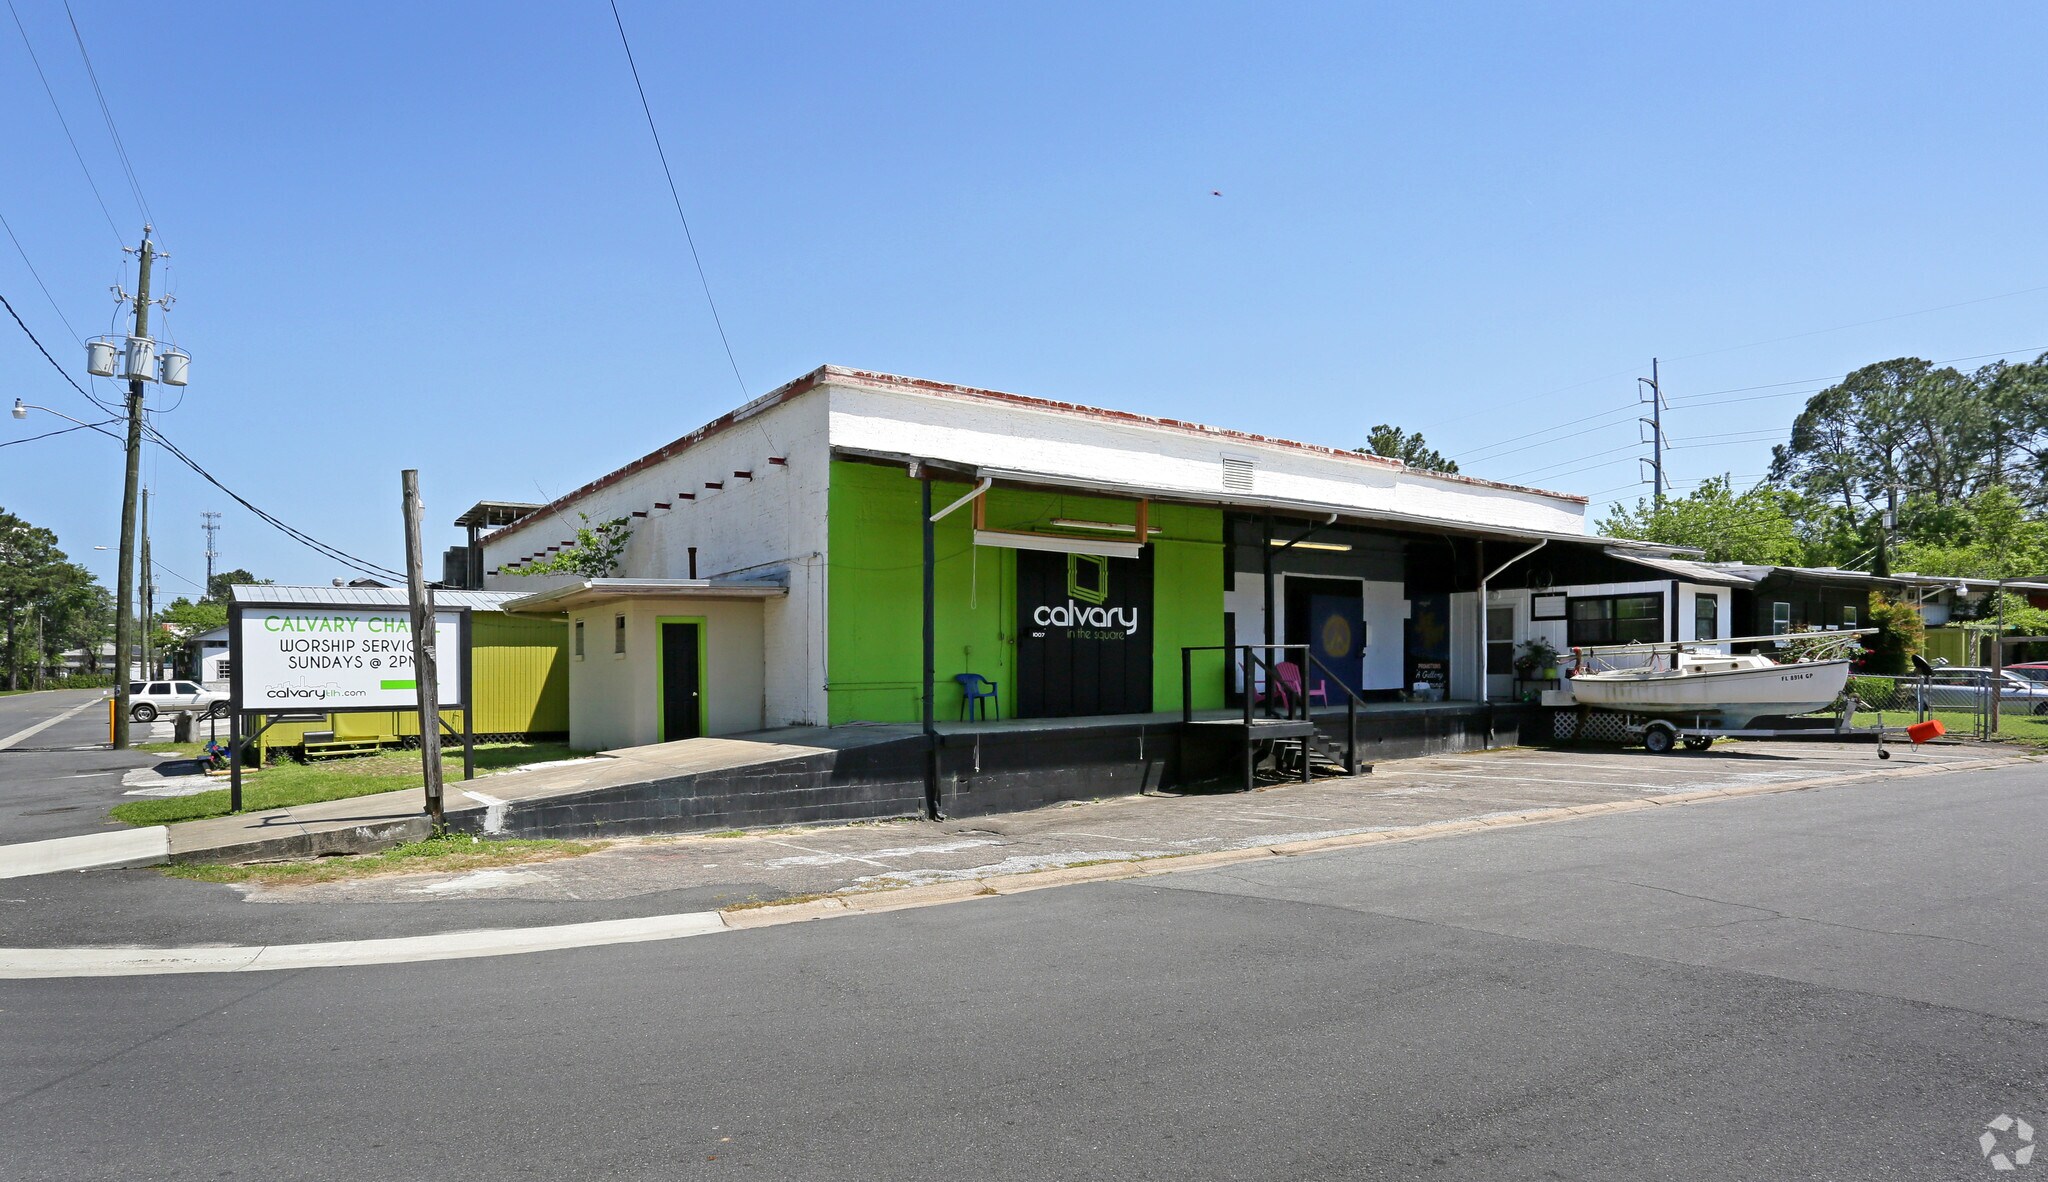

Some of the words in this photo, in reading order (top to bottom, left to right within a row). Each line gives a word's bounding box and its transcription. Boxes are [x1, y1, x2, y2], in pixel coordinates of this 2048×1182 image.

[1033, 599, 1138, 635] calvary
[264, 615, 359, 633] CALVARY
[1067, 629, 1076, 639] in
[1077, 628, 1091, 639] the
[1094, 630, 1125, 641] square
[280, 639, 355, 652] WORSHIP
[361, 639, 415, 653] SERVIC
[288, 656, 363, 669] SUNDAYS
[369, 658, 382, 669] @
[266, 687, 367, 700] calvarytlh.com
